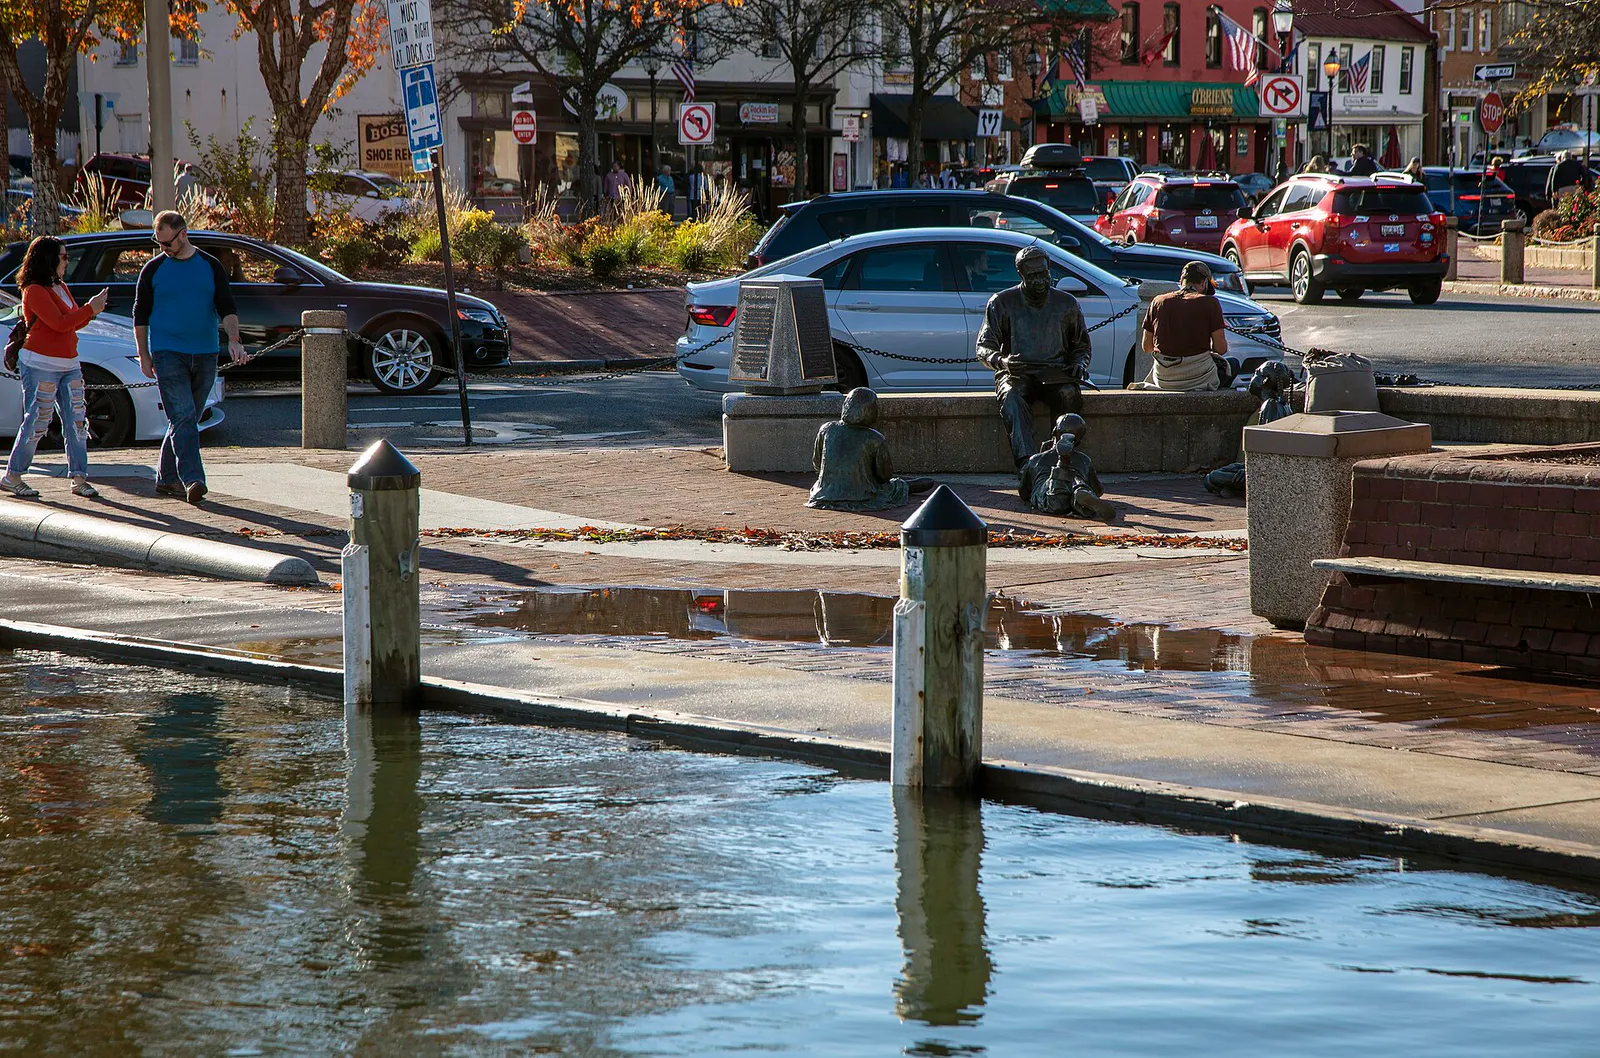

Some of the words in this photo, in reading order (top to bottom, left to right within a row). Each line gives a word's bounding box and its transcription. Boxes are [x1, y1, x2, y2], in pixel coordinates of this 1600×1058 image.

[400, 2, 418, 23] MUST
[394, 27, 408, 45] TURN
[414, 21, 429, 39] RIGHT
[396, 49, 403, 65] AT
[406, 42, 424, 63] DOCK
[426, 43, 433, 59] ST
[1486, 68, 1497, 76] ONE
[1498, 67, 1510, 76] WAY
[1192, 87, 1233, 105] O'BRIEN'S
[1483, 104, 1502, 121] STOP
[366, 148, 392, 161] SHOE
